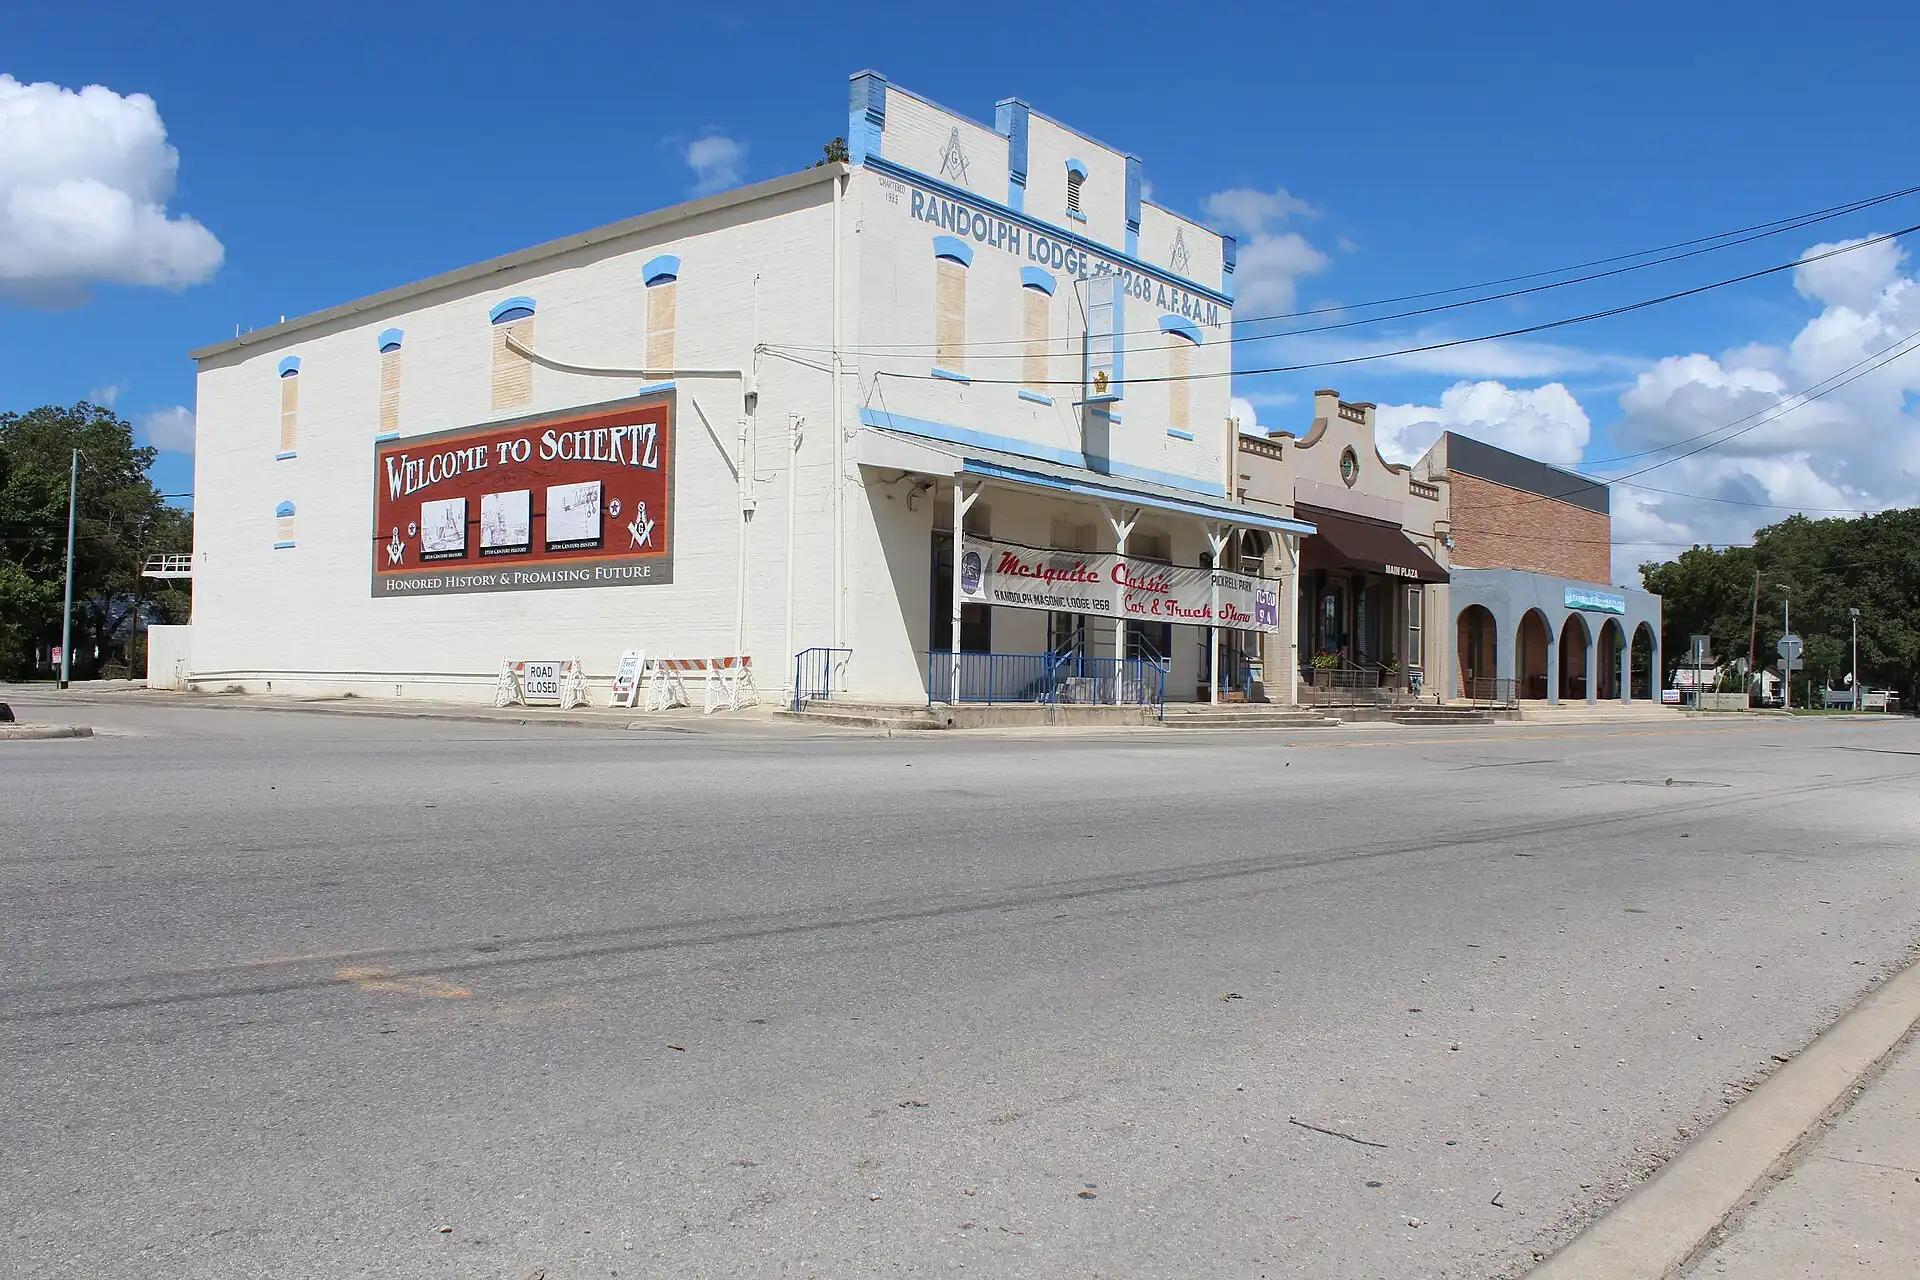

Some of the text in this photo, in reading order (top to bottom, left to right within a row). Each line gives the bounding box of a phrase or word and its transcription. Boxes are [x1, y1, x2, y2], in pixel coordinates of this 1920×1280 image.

[878, 177, 906, 194] CHARTERED
[911, 188, 1020, 255] RANDOLPH
[1027, 233, 1088, 279] LODGE
[539, 423, 659, 469] SCHERTZ
[386, 565, 651, 591] HONORED HISTORY & PROMISING FUTURE
[996, 551, 1169, 594] Mesquite Classic
[1385, 564, 1419, 579] MAIN PLAZA
[1211, 575, 1253, 592] PICKRELL PARK
[994, 589, 1110, 611] RANDOLPH MASONIC LODGE 1268
[1124, 594, 1251, 623] Car & Truck Show
[530, 666, 553, 678] ROAD
[527, 681, 558, 694] CLOSED
